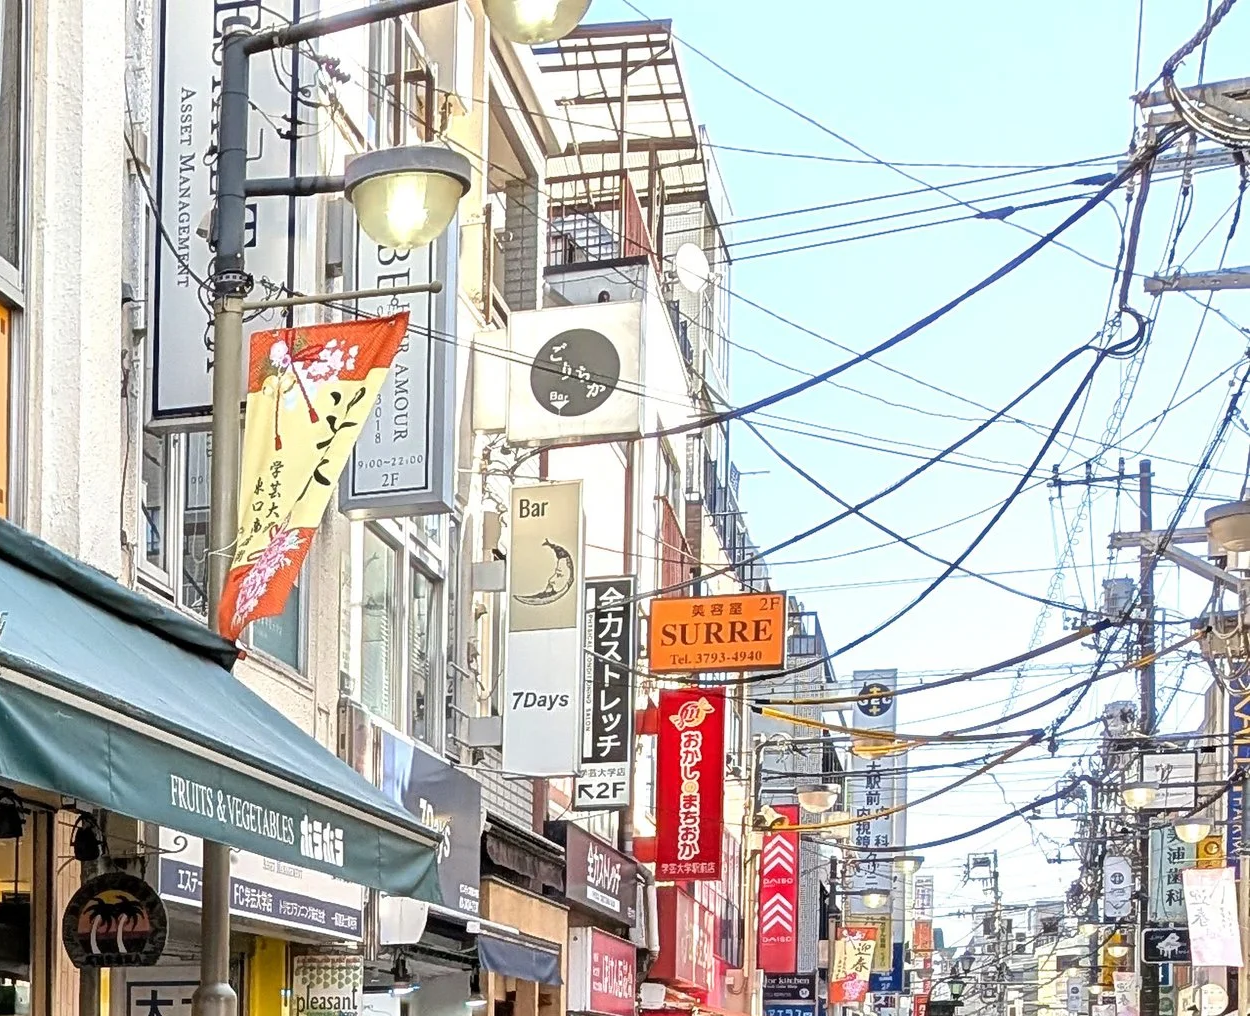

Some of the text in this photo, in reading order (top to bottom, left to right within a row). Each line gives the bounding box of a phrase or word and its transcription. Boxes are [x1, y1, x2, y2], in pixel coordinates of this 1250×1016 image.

[176, 87, 197, 288] ASSET MANAGEMENT
[392, 363, 410, 442] AMOUR
[549, 391, 569, 401] Bar
[381, 473, 400, 488] 2F
[519, 499, 548, 520] Bar
[691, 602, 743, 617] 美容室
[759, 597, 781, 611] 2F
[660, 618, 773, 647] SURRE
[670, 650, 763, 665] Tel. 3793-4940
[511, 691, 570, 711] 7Days
[596, 781, 626, 800] 2F
[677, 730, 703, 862] おかしのまちおか
[170, 774, 295, 846] FRUITS & VEGETABLES
